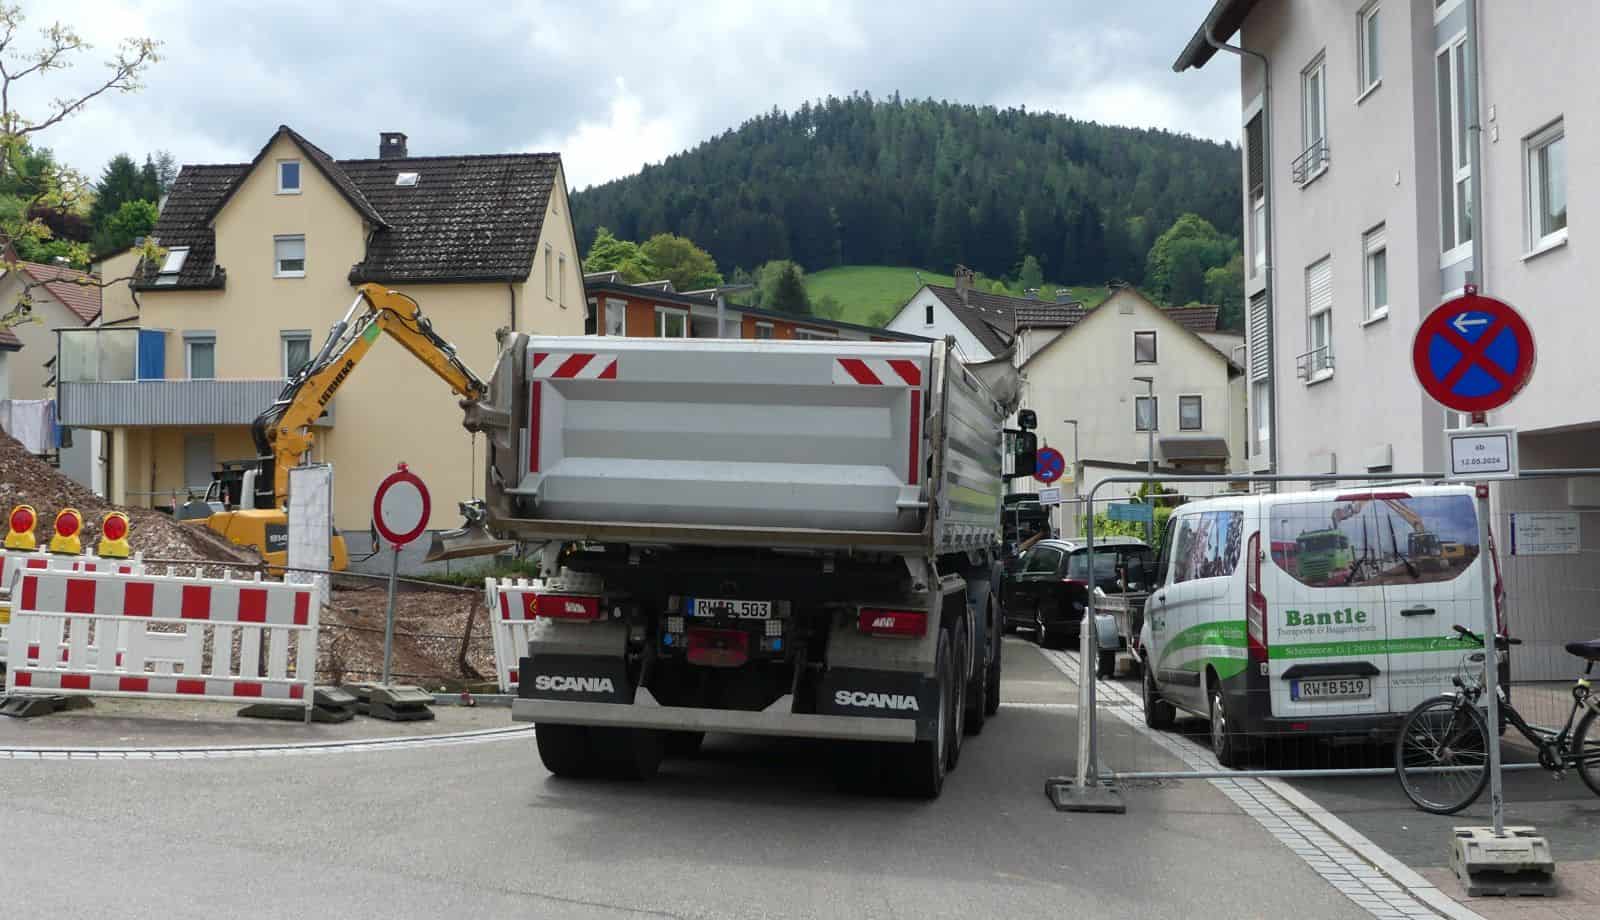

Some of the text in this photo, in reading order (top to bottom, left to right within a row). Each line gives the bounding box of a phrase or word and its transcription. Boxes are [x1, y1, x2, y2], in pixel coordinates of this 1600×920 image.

[318, 360, 355, 406] LIEBHERR
[741, 602, 769, 617] 503
[1286, 608, 1367, 626] Bantle
[535, 675, 615, 693] SCANIA
[1303, 679, 1364, 696] RW B 519
[834, 690, 920, 711] SCANIA
